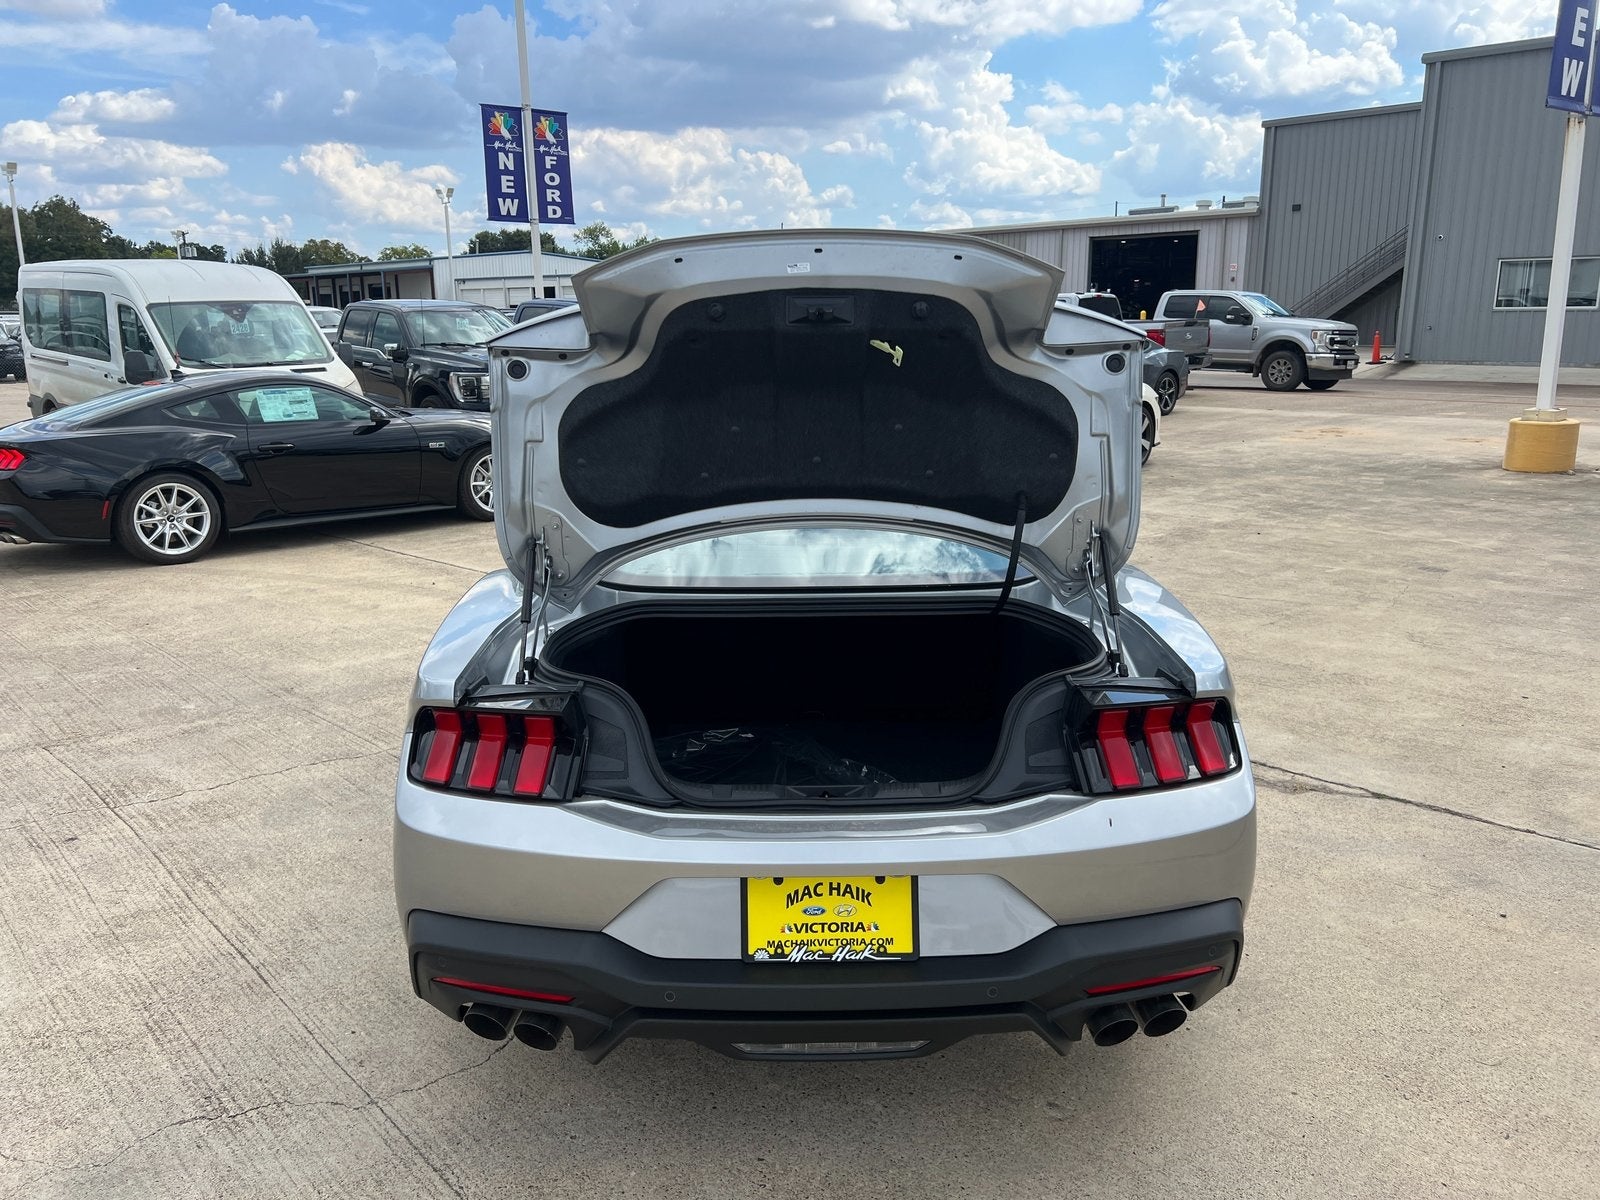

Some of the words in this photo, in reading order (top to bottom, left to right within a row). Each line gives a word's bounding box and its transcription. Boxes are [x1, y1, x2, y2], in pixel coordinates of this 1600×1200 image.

[498, 152, 519, 216] NEW
[544, 155, 562, 219] FORD
[786, 882, 824, 908] MAC
[828, 881, 873, 907] HAIK
[804, 906, 824, 916] Ford
[793, 921, 867, 934] VICTORIA
[766, 937, 894, 949] MACHAIKVICTORIA.COM
[786, 944, 830, 962] Mac
[831, 944, 884, 962] Haik
